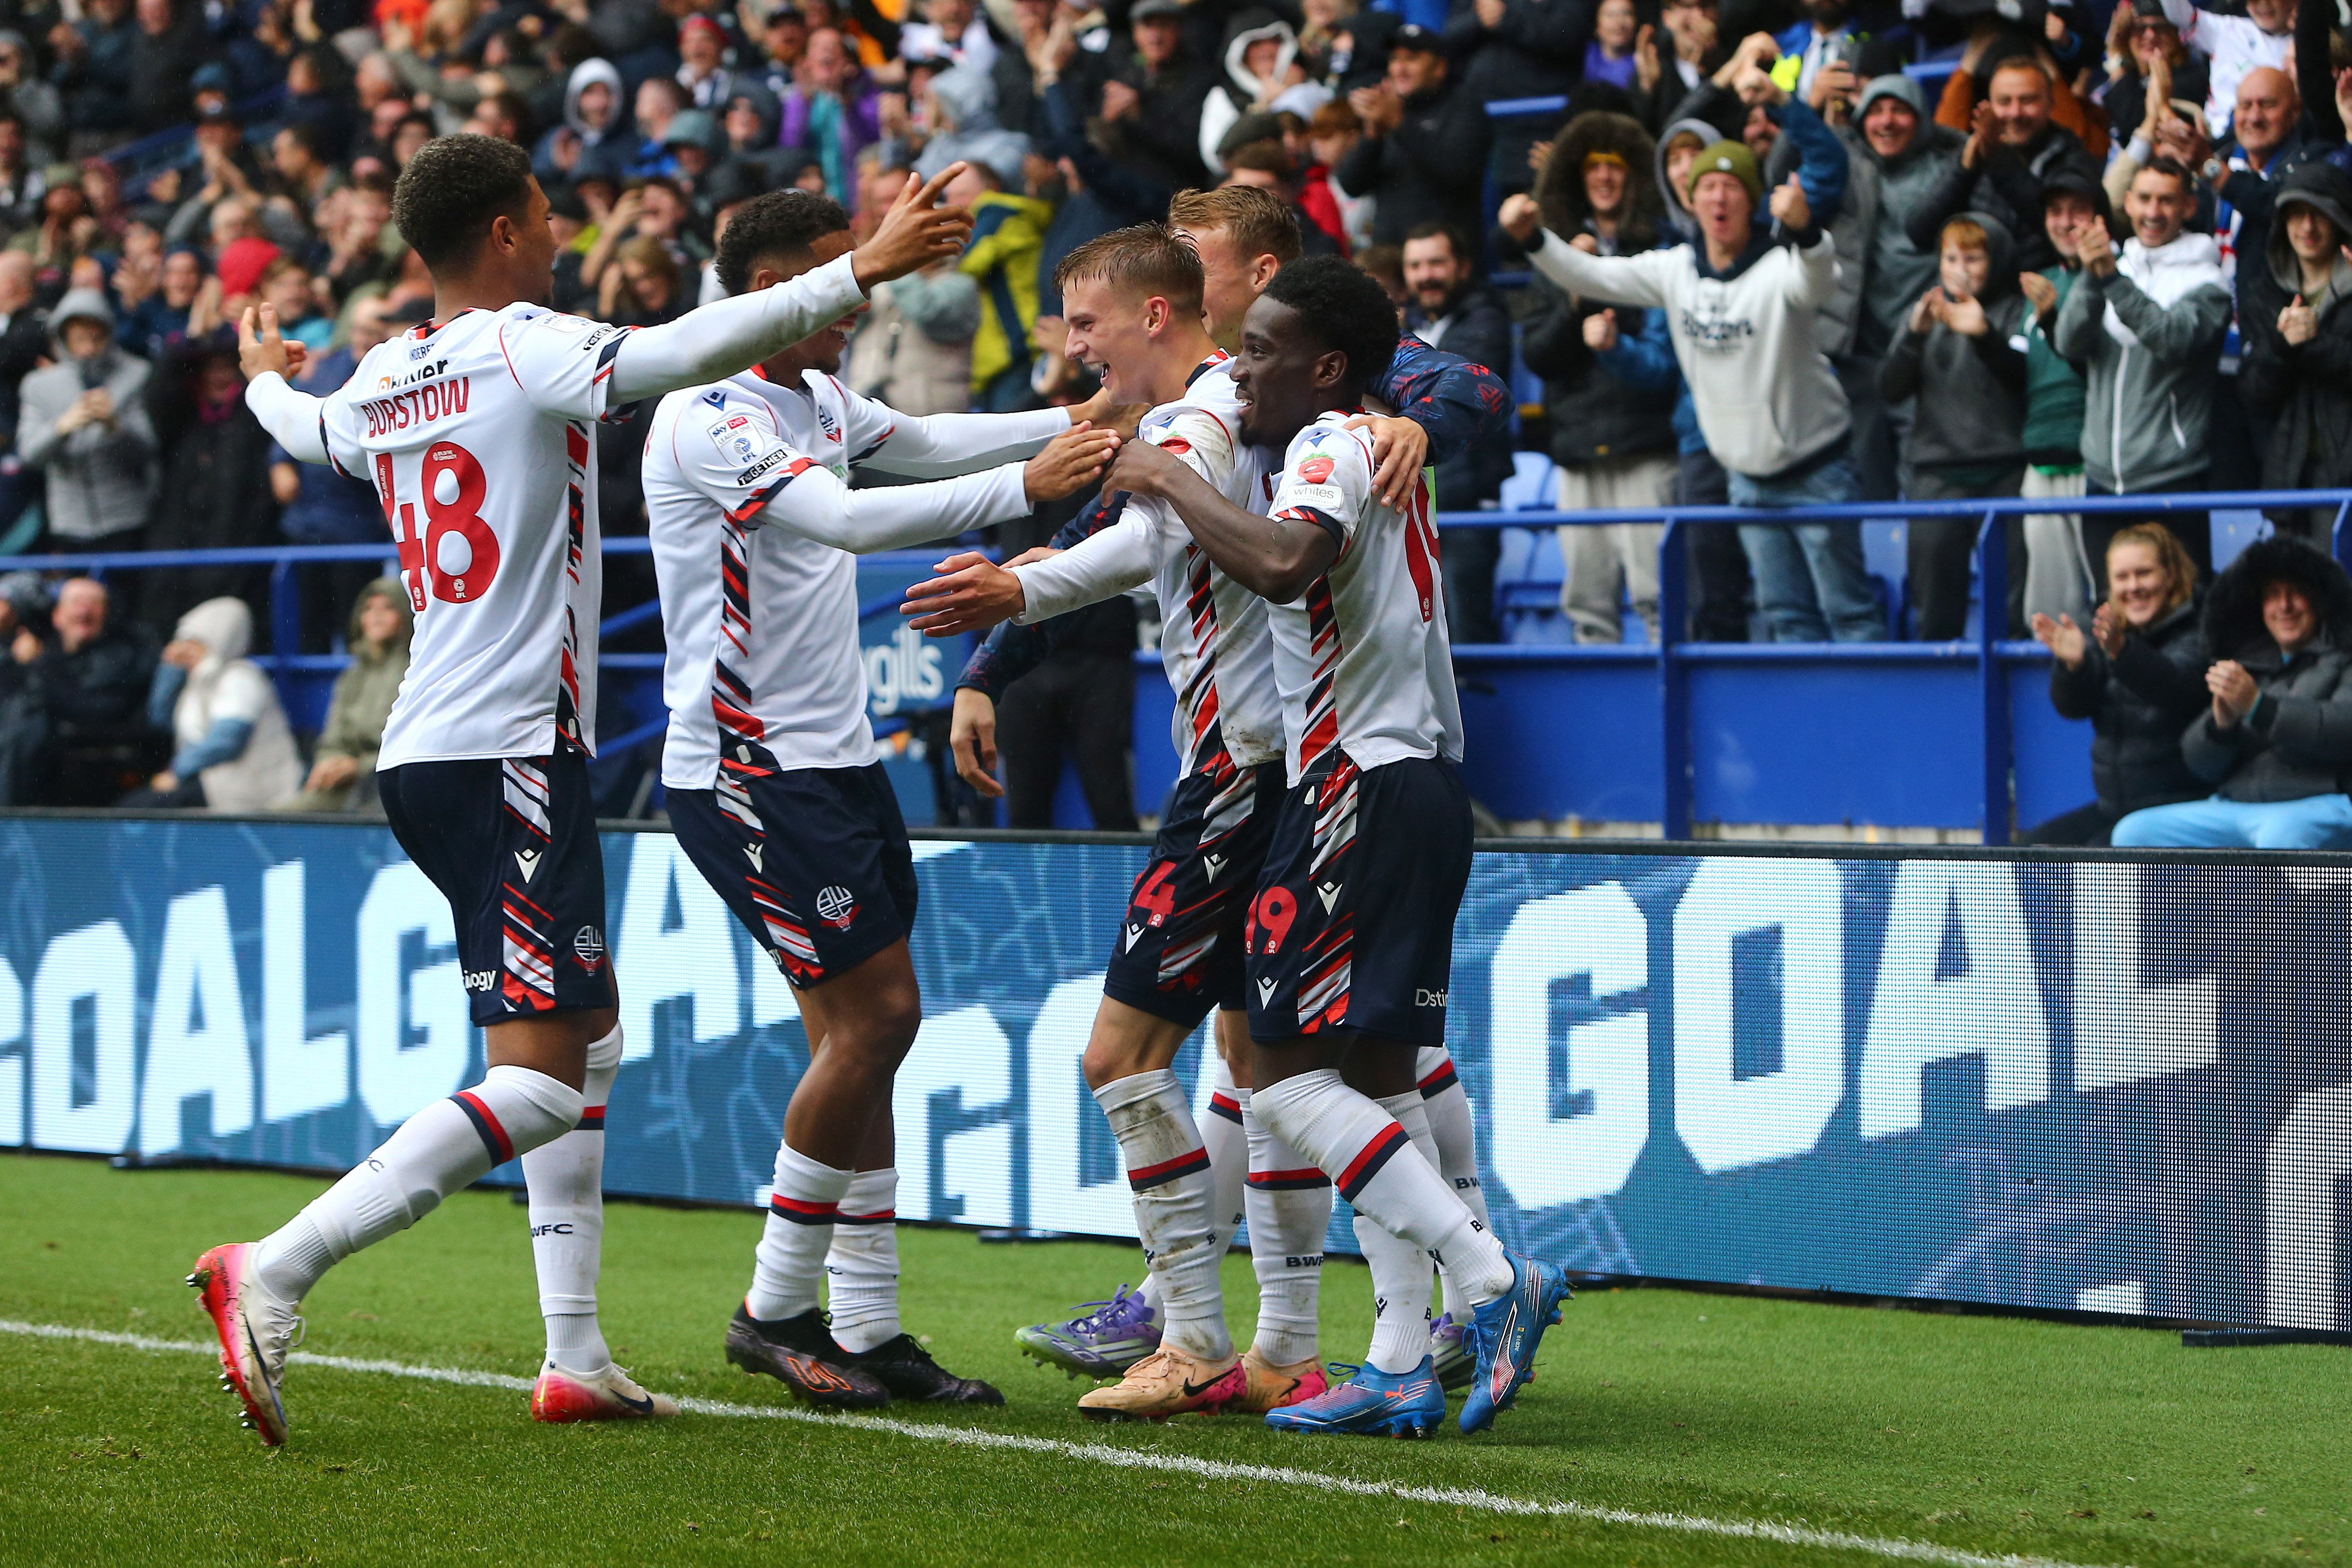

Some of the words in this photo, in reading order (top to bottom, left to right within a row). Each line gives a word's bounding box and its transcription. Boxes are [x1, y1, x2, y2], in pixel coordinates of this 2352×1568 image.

[360, 376, 469, 438] BURSTOW
[713, 425, 727, 437] sky
[728, 417, 747, 428] bet
[738, 451, 787, 485] TOGETHER
[742, 451, 757, 463] EFL
[1294, 486, 1334, 499] whites
[376, 441, 500, 611] 48
[862, 622, 944, 716] gills
[1126, 860, 1177, 927] 4
[1245, 886, 1297, 954] 19
[531, 1223, 573, 1237] WFC
[1286, 1256, 1323, 1267] BWF
